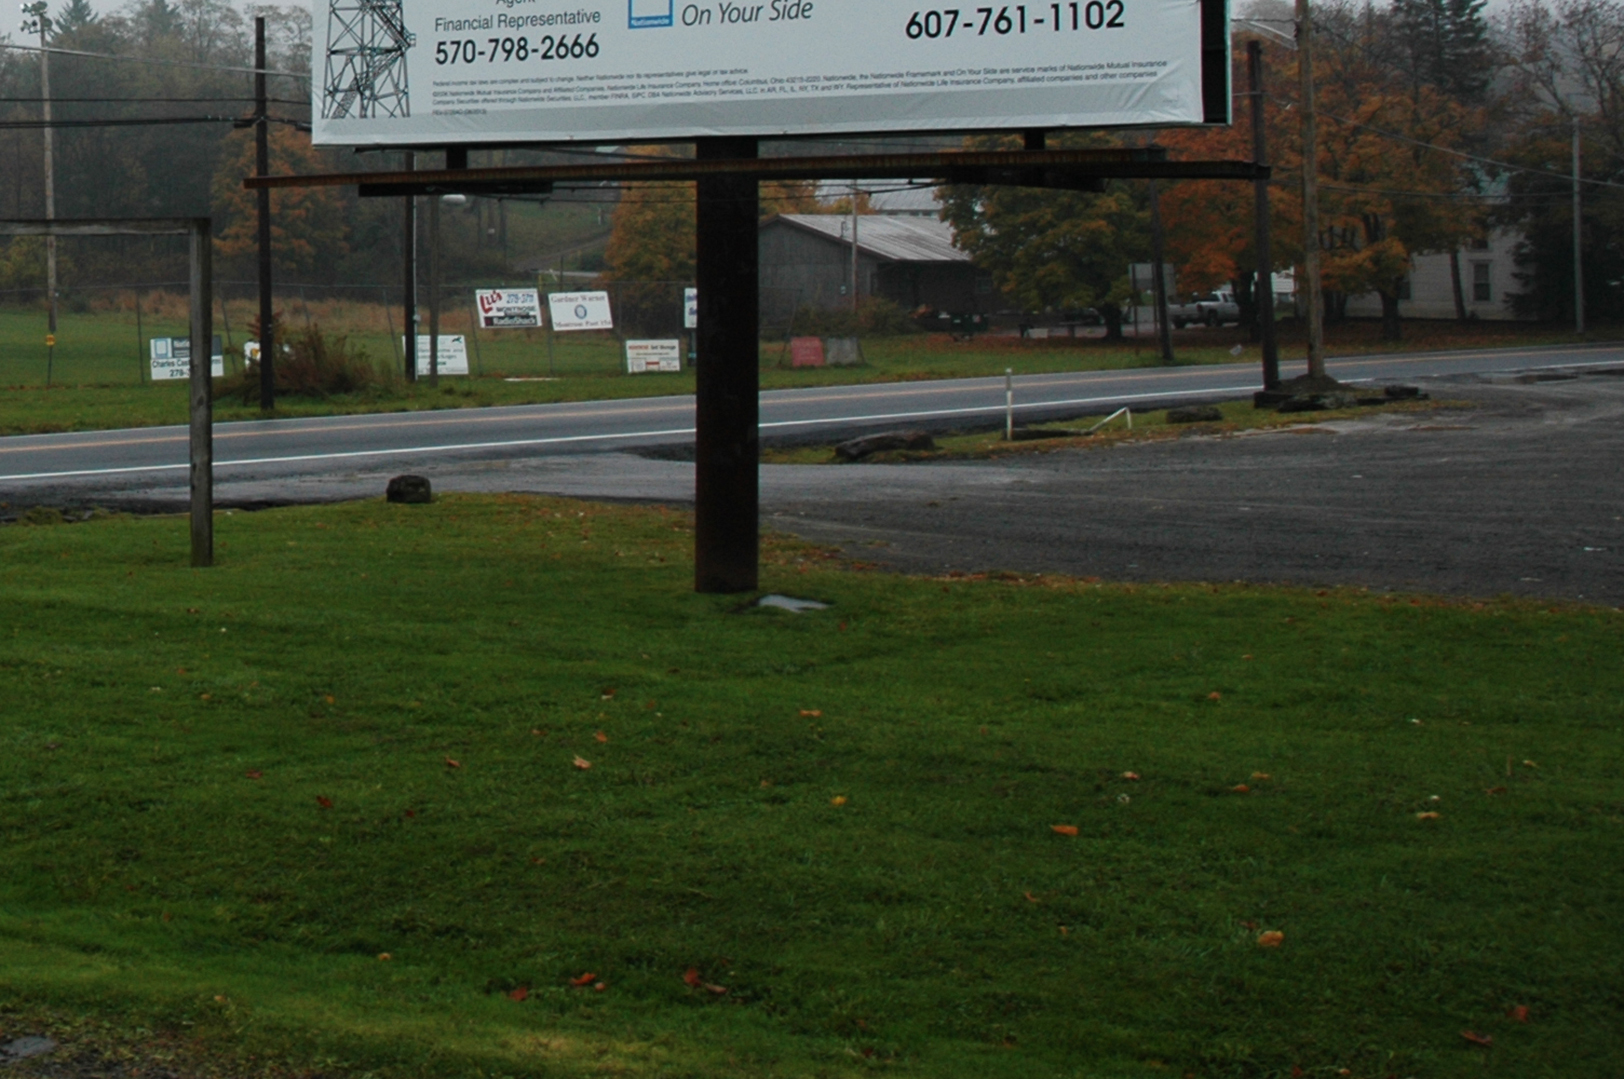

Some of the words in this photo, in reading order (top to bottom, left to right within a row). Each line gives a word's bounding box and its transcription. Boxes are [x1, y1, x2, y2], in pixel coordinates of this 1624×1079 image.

[434, 15, 493, 32] Financial
[497, 8, 601, 31] Representative
[681, 3, 712, 27] On
[718, 0, 764, 24] Your
[435, 32, 600, 65] 570-798-2666
